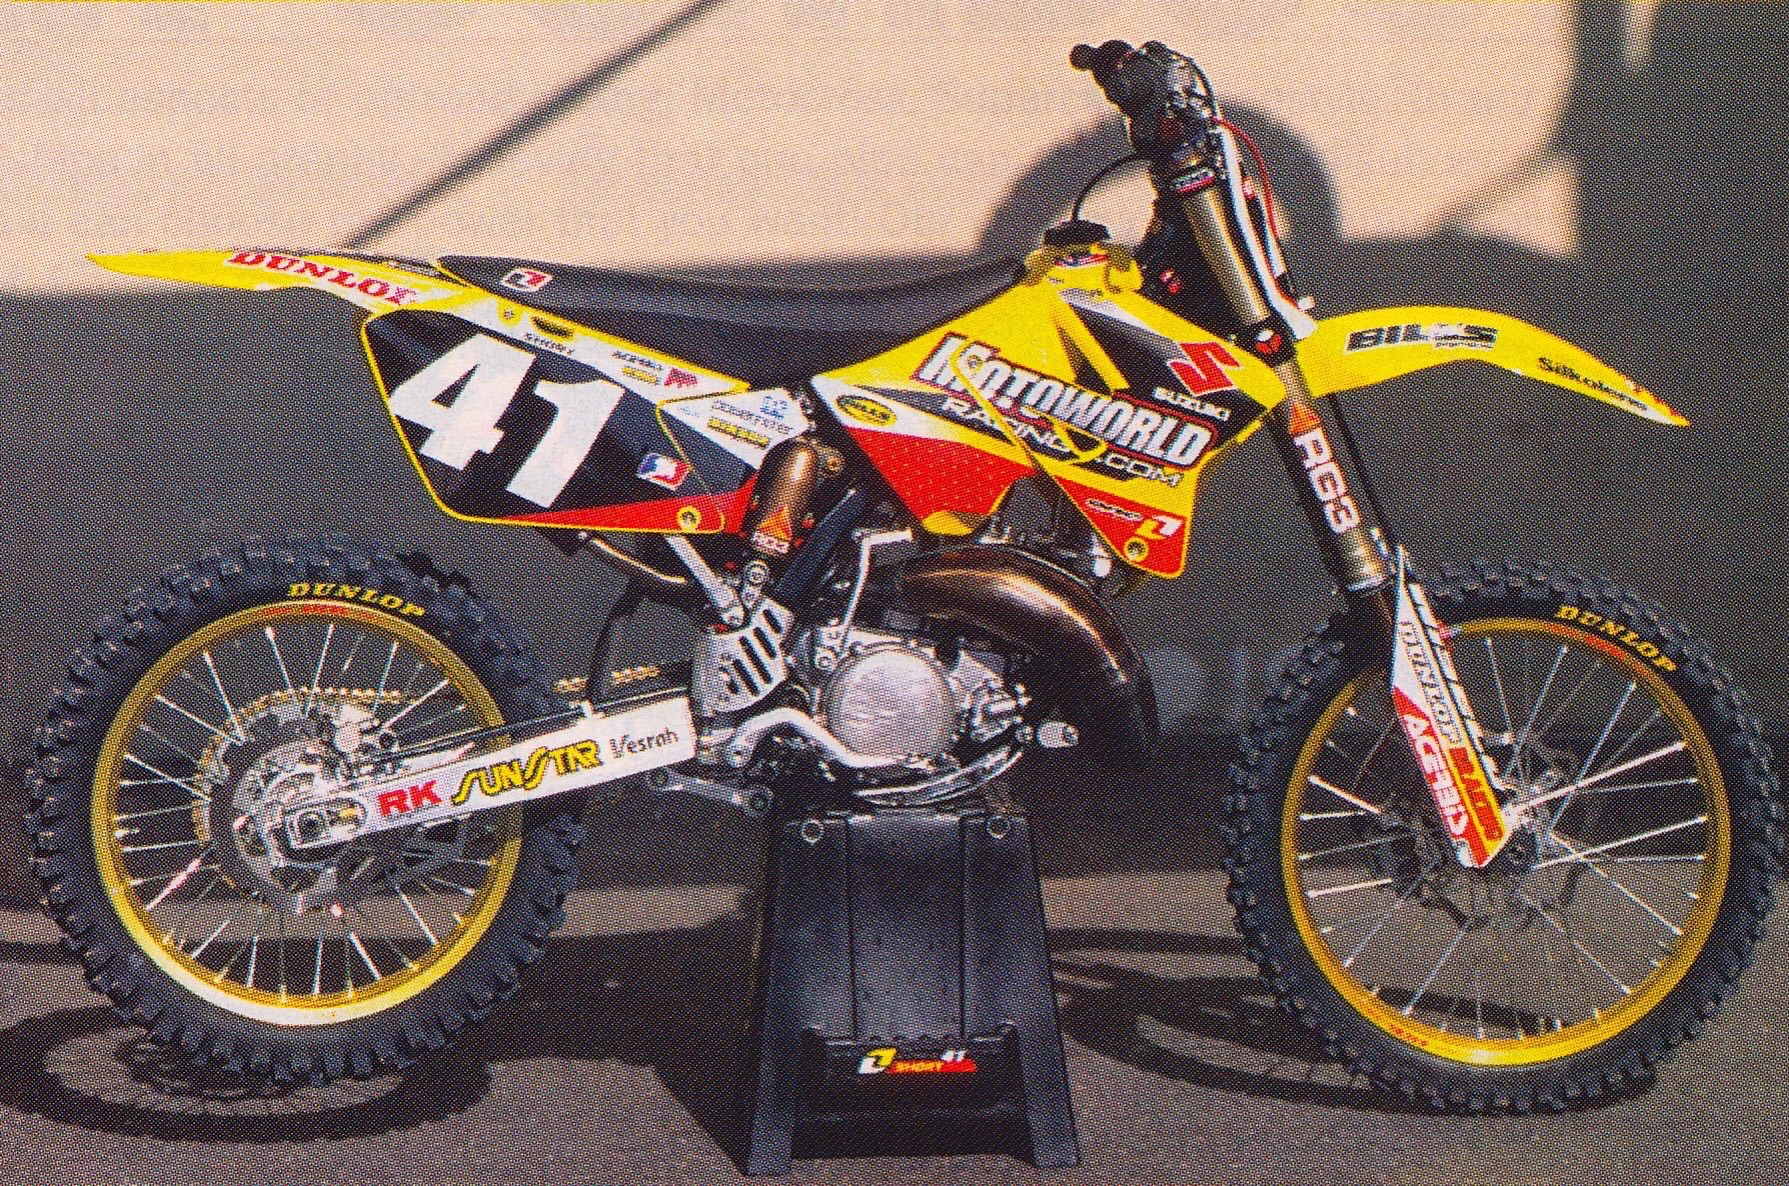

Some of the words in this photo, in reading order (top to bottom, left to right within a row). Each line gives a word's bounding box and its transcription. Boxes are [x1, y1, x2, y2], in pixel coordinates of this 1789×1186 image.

[228, 251, 417, 305] DUNLOP
[390, 332, 626, 509] 41
[914, 333, 1215, 468] MOTOWORLD
[1152, 386, 1231, 421] SUZUKI
[1292, 427, 1361, 534] RG3
[288, 581, 426, 617] DUNLOP
[1555, 604, 1680, 671] DUNLOP
[1397, 620, 1462, 744] DUNLOP
[376, 779, 443, 817] RK
[451, 738, 604, 805] SUNSTAR
[609, 726, 680, 759] Vesrah
[1403, 714, 1469, 836] ACERBIS
